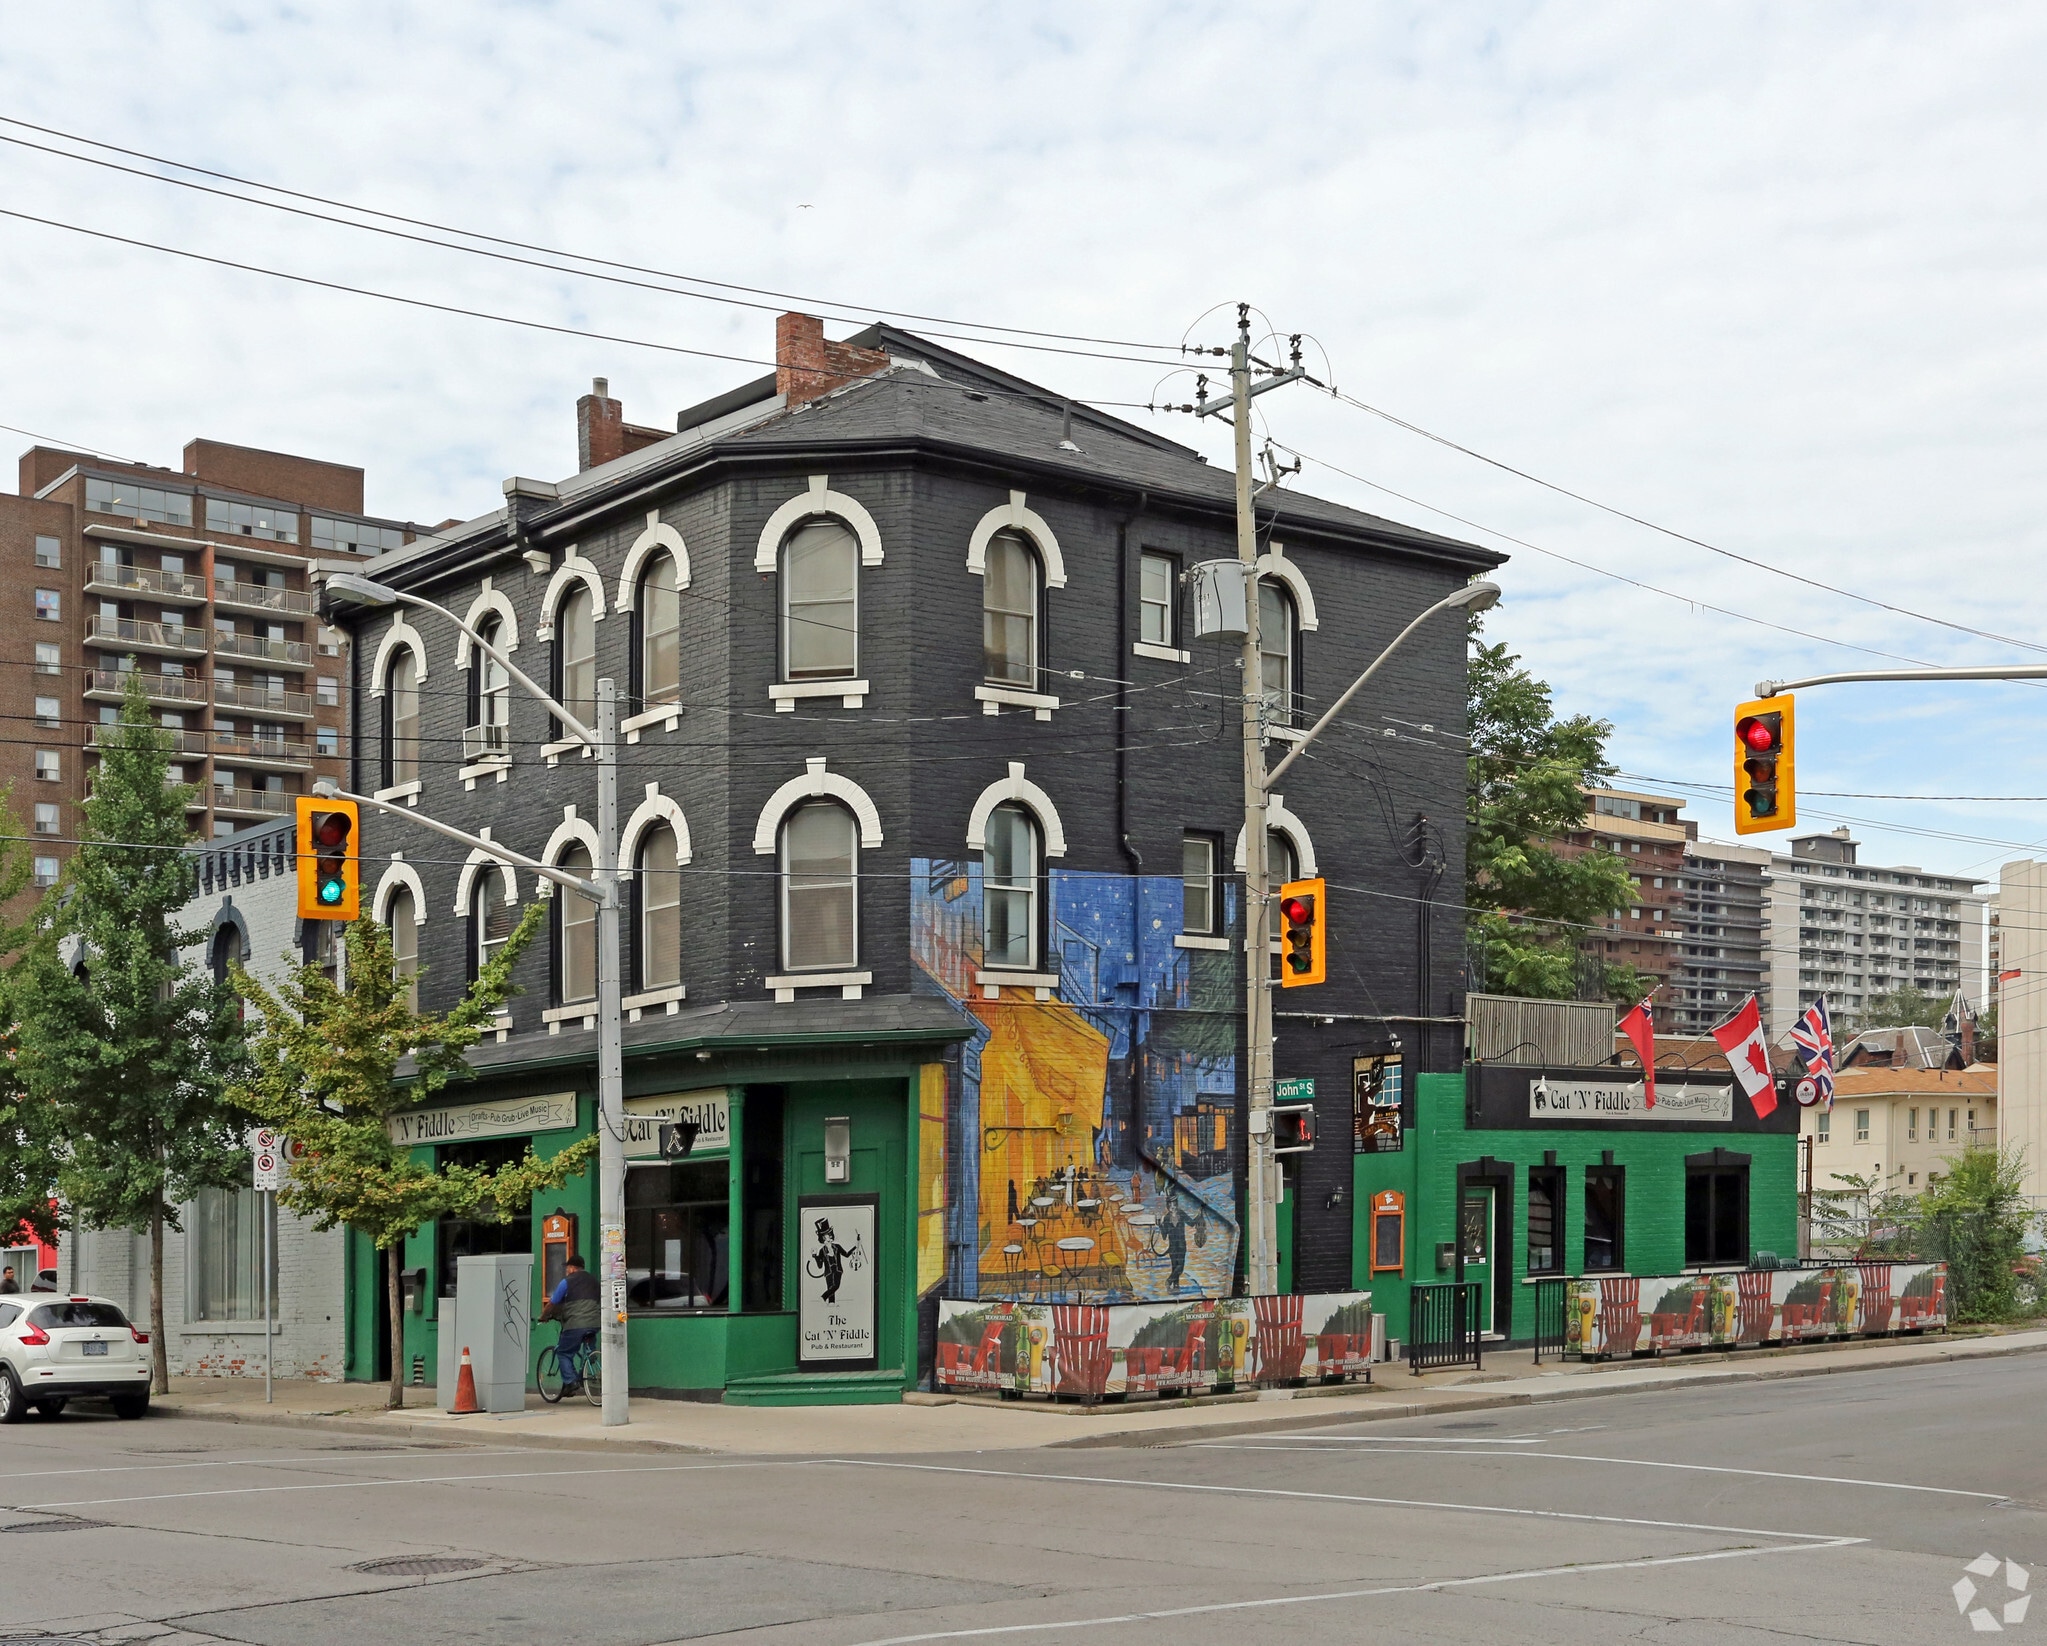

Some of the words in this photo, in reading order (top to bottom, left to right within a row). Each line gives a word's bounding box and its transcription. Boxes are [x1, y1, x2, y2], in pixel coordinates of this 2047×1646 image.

[1276, 1083, 1299, 1097] John
[1299, 1082, 1306, 1090] St
[1306, 1081, 1313, 1095] S
[1550, 1089, 1571, 1110] Cat
[1594, 1090, 1630, 1111] Fiddle
[471, 1111, 488, 1122] Drafts
[489, 1112, 501, 1123] Pub
[501, 1111, 515, 1123] Grub
[517, 1109, 530, 1120] Live
[529, 1103, 548, 1116] Music
[416, 1112, 455, 1139] Fiddle
[827, 1315, 847, 1326] The
[804, 1331, 820, 1341] Cat
[840, 1328, 870, 1340] Fiddle
